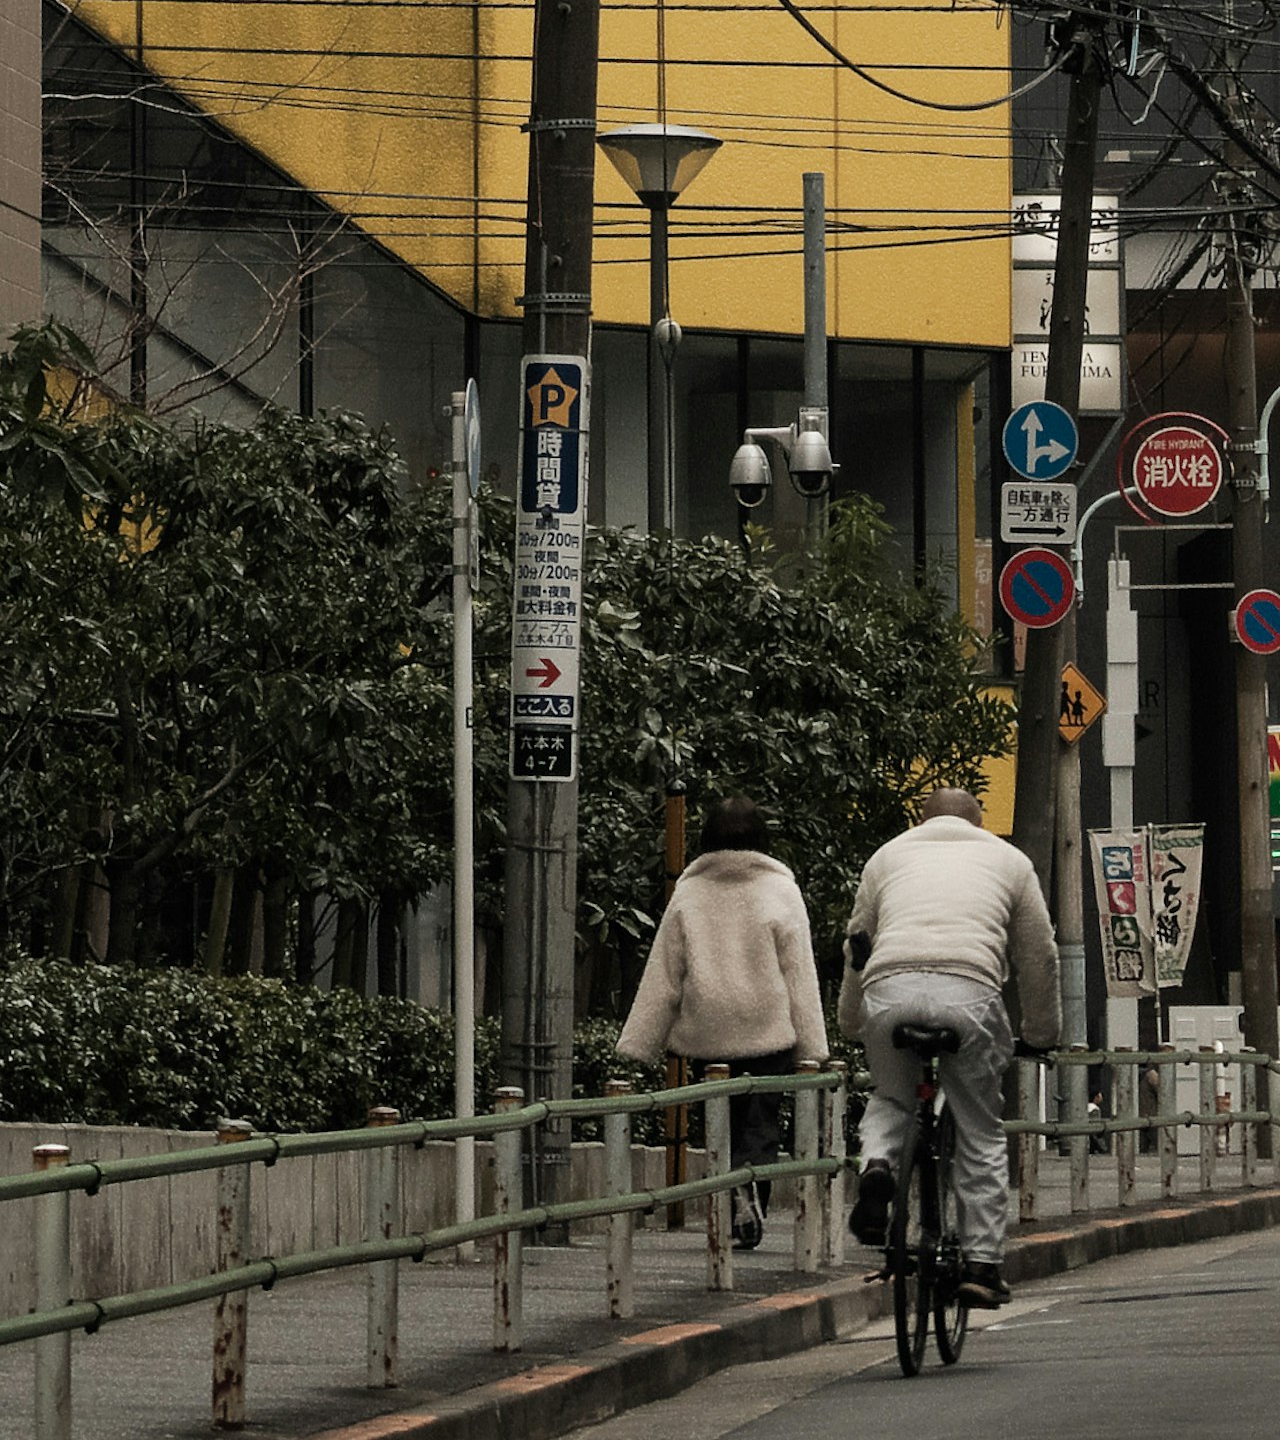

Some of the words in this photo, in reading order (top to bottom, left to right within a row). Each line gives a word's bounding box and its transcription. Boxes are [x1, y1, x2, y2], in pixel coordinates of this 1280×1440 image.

[540, 384, 566, 420] P
[1148, 440, 1167, 451] FIRE
[1168, 439, 1206, 450] HYDRANT
[536, 431, 562, 510] 時間貸
[1143, 455, 1214, 488] 消火栓
[1007, 506, 1070, 523] 一方通行
[517, 698, 571, 715] ここ入る
[521, 735, 564, 750] 六本木
[525, 755, 557, 771] 4-7
